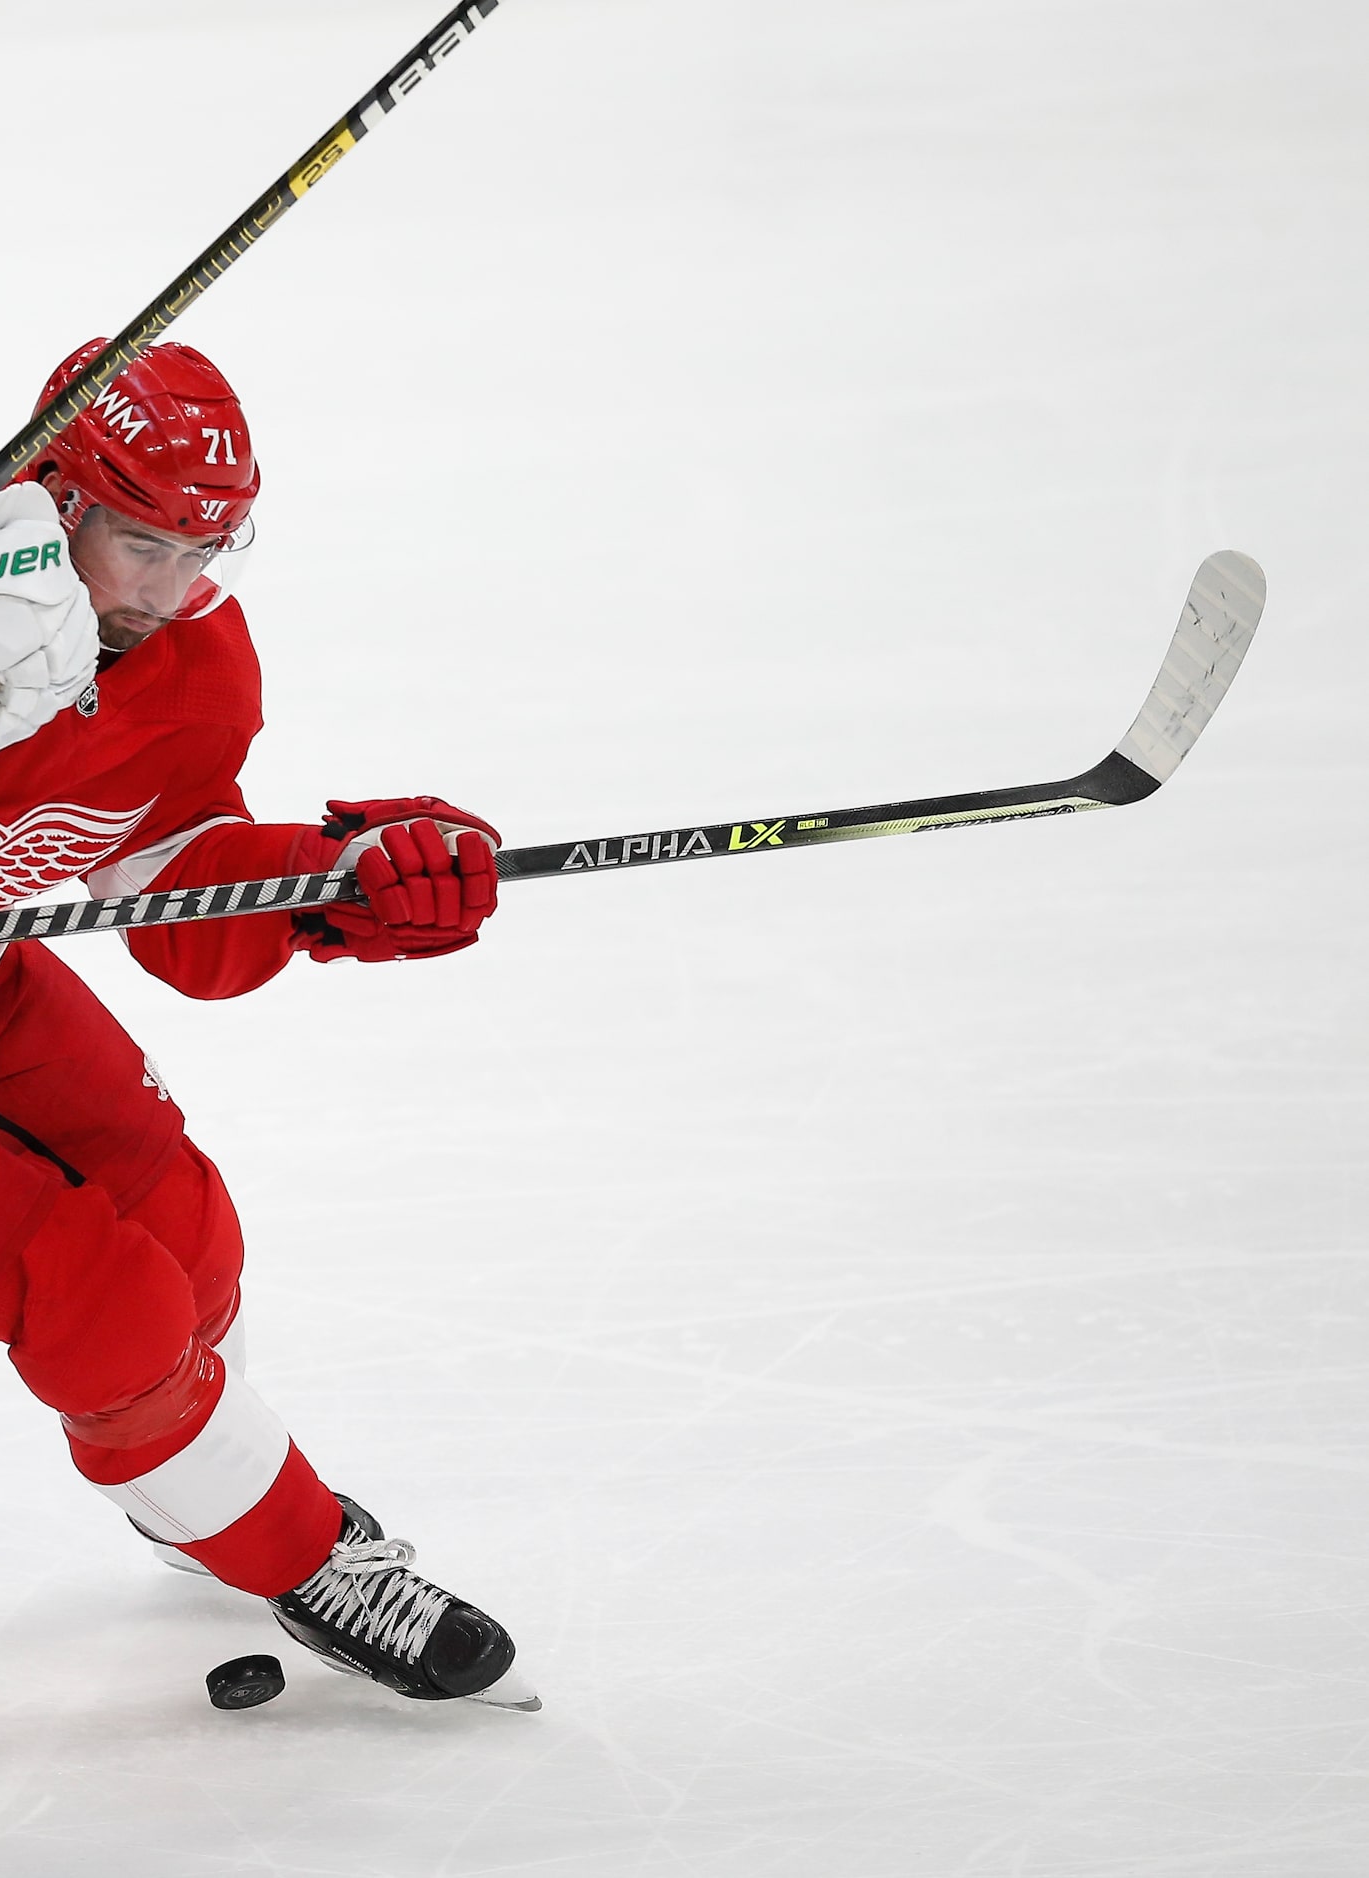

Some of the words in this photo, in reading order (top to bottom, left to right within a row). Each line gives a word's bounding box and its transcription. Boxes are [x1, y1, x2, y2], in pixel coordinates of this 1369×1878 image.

[92, 381, 150, 445] WM
[201, 427, 238, 466] 71
[560, 830, 713, 871] ALPHA
[727, 819, 788, 851] LX
